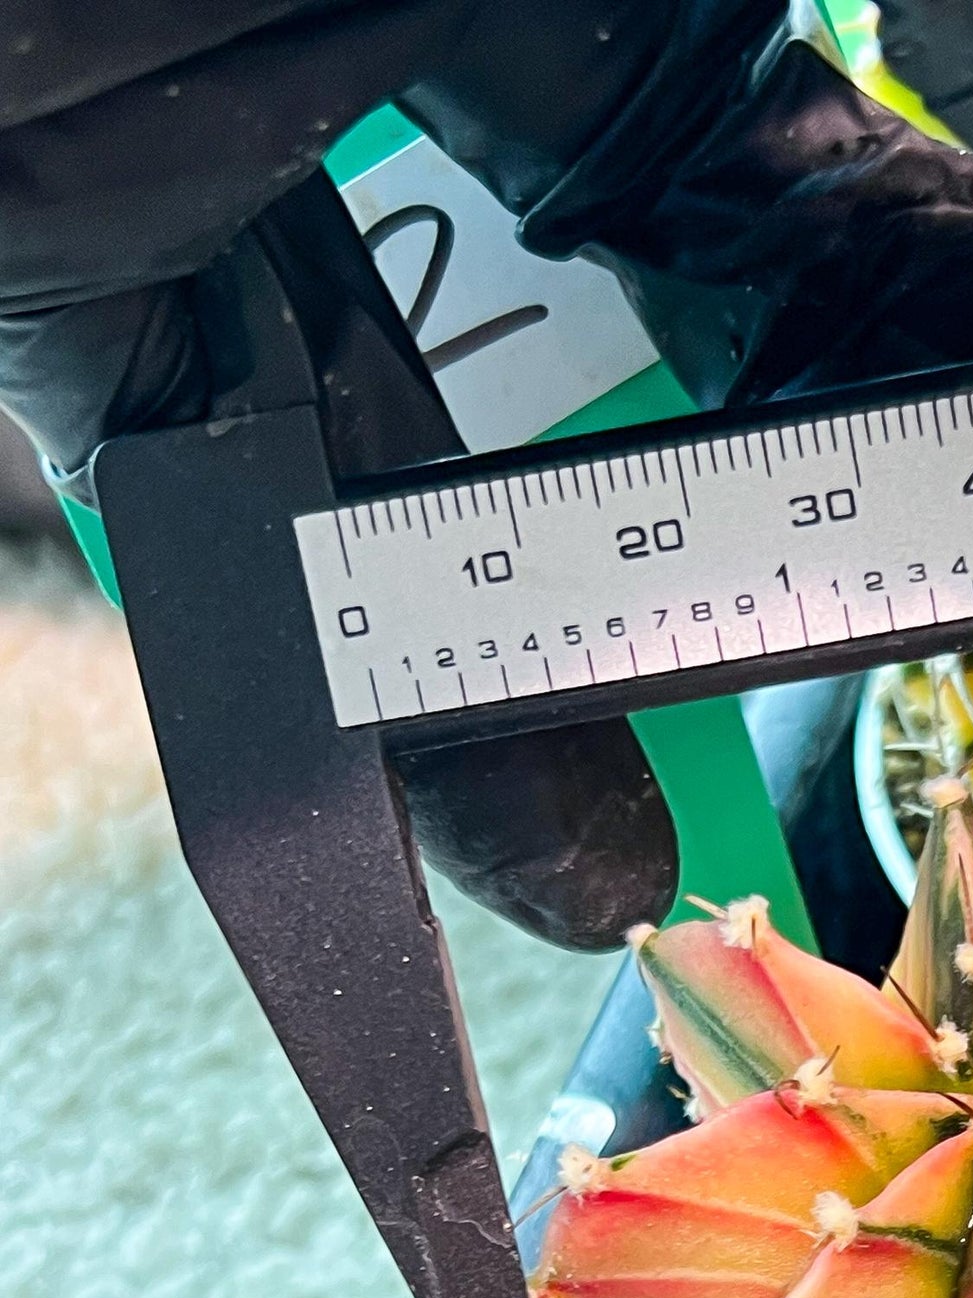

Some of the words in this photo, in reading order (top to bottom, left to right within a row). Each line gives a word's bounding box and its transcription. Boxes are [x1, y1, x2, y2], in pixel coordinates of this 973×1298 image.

[337, 605, 370, 639] 0
[461, 550, 514, 588] 10
[615, 518, 685, 561] 20
[787, 487, 858, 528] 30
[401, 655, 412, 674] 1
[434, 647, 457, 669] 2
[477, 639, 499, 660] 3
[521, 632, 540, 652] 4
[561, 624, 583, 646] 5
[605, 616, 626, 638] 6
[651, 608, 669, 629] 7
[690, 601, 713, 623] 8
[734, 593, 755, 616] 9
[774, 562, 791, 594] 1
[830, 579, 840, 598] 1
[863, 570, 885, 592] 2
[906, 562, 928, 583] 3
[950, 555, 969, 575] 4
